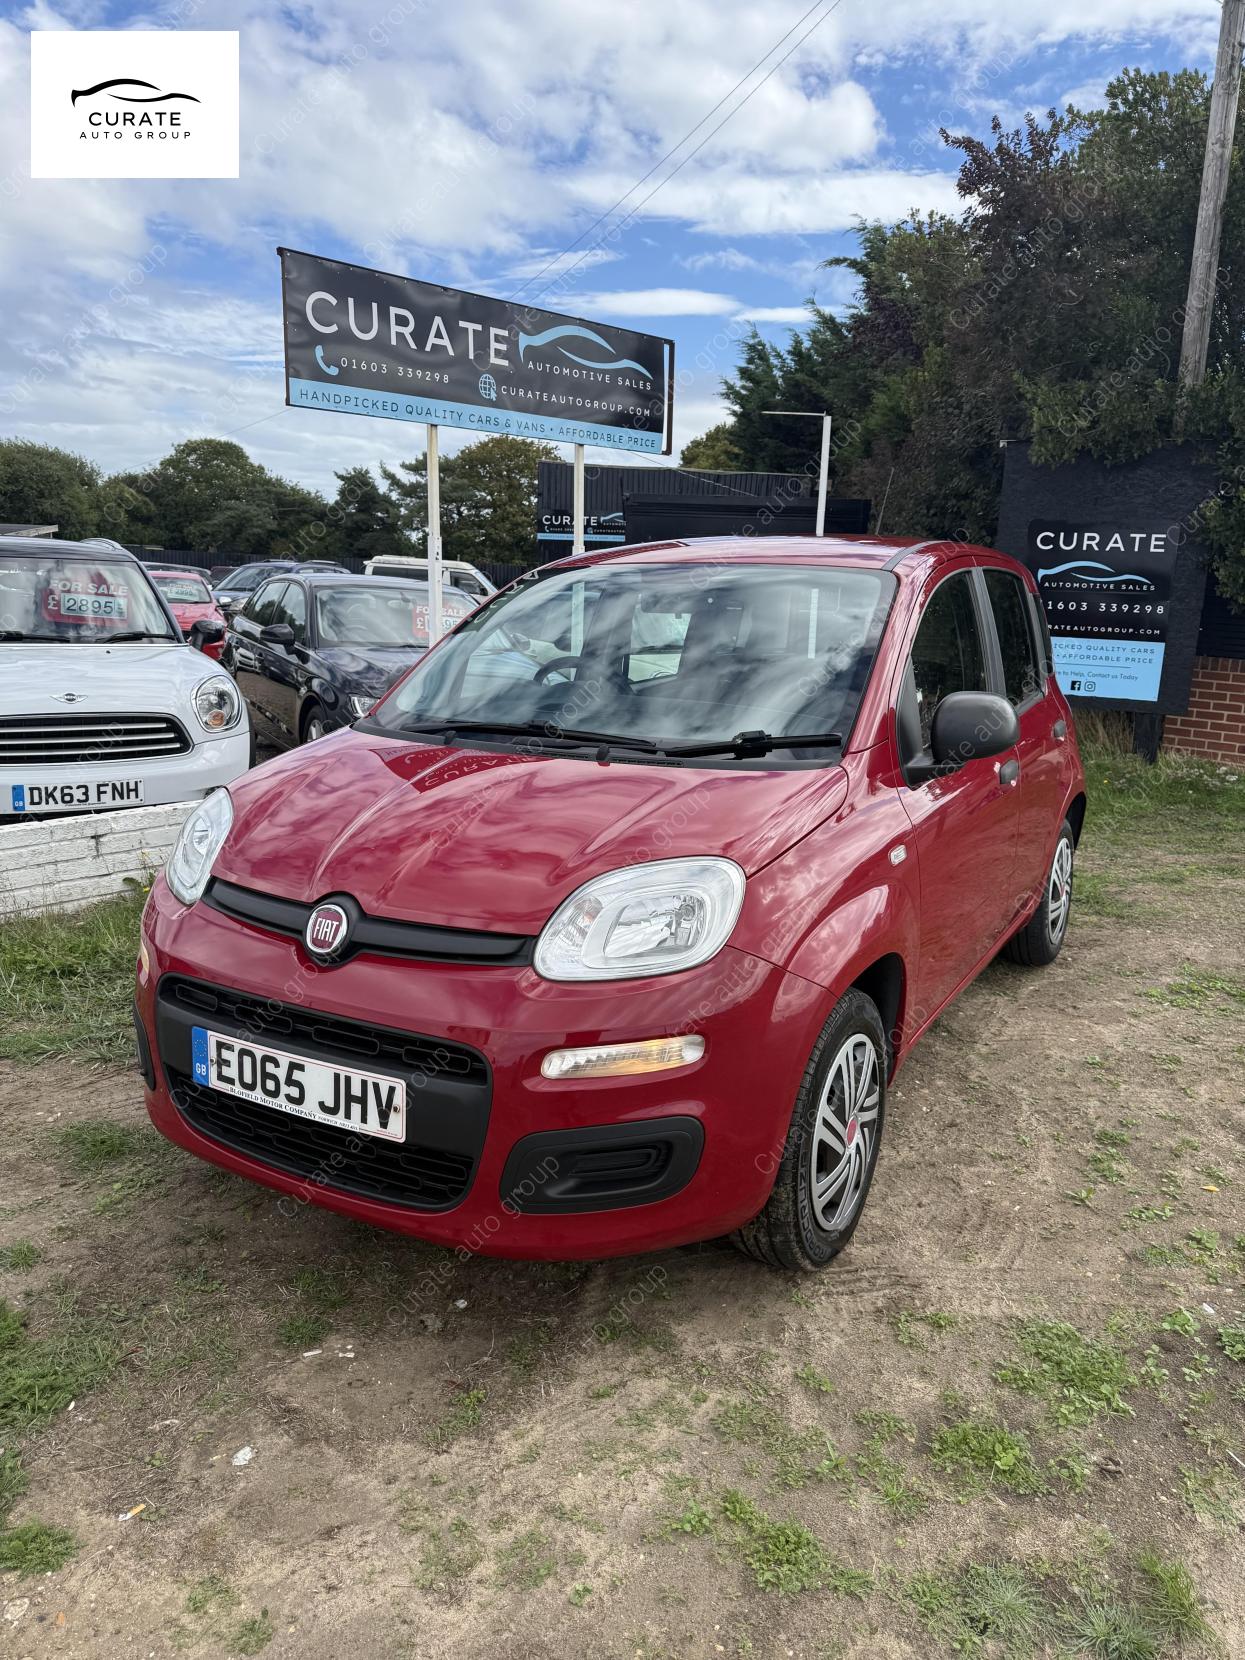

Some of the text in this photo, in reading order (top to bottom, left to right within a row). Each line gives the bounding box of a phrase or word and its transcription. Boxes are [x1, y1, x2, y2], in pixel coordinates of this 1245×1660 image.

[305, 290, 509, 367] CURATE
[340, 357, 449, 384] 01603 339298
[528, 360, 652, 391] AUTOMOTIVE SALES
[501, 385, 651, 417] CURATEAUTOGROUP.COM
[300, 388, 656, 448] HANDPICKED QUALITY CARS & VANS AFFORDABLE PRICE
[542, 514, 598, 526] CURTE
[1036, 531, 1167, 553] CURATE
[48, 579, 129, 597] FOR SALE
[1044, 581, 1156, 591] AUTOMOTIVE SALES
[66, 597, 114, 615] 2895
[1098, 602, 1165, 614] 339298
[1062, 653, 1153, 665] AFFORDABLE PRICE
[1086, 645, 1127, 653] QUALITY
[1131, 647, 1155, 655] CARS
[28, 780, 139, 806] DK63 FNH
[313, 917, 340, 943] FIAT
[195, 1062, 207, 1077] GB
[229, 1086, 259, 1103] BLOFIELD
[259, 1096, 283, 1110] MOTOR
[284, 1104, 318, 1120] COMPANY
[318, 1072, 397, 1130] JHV
